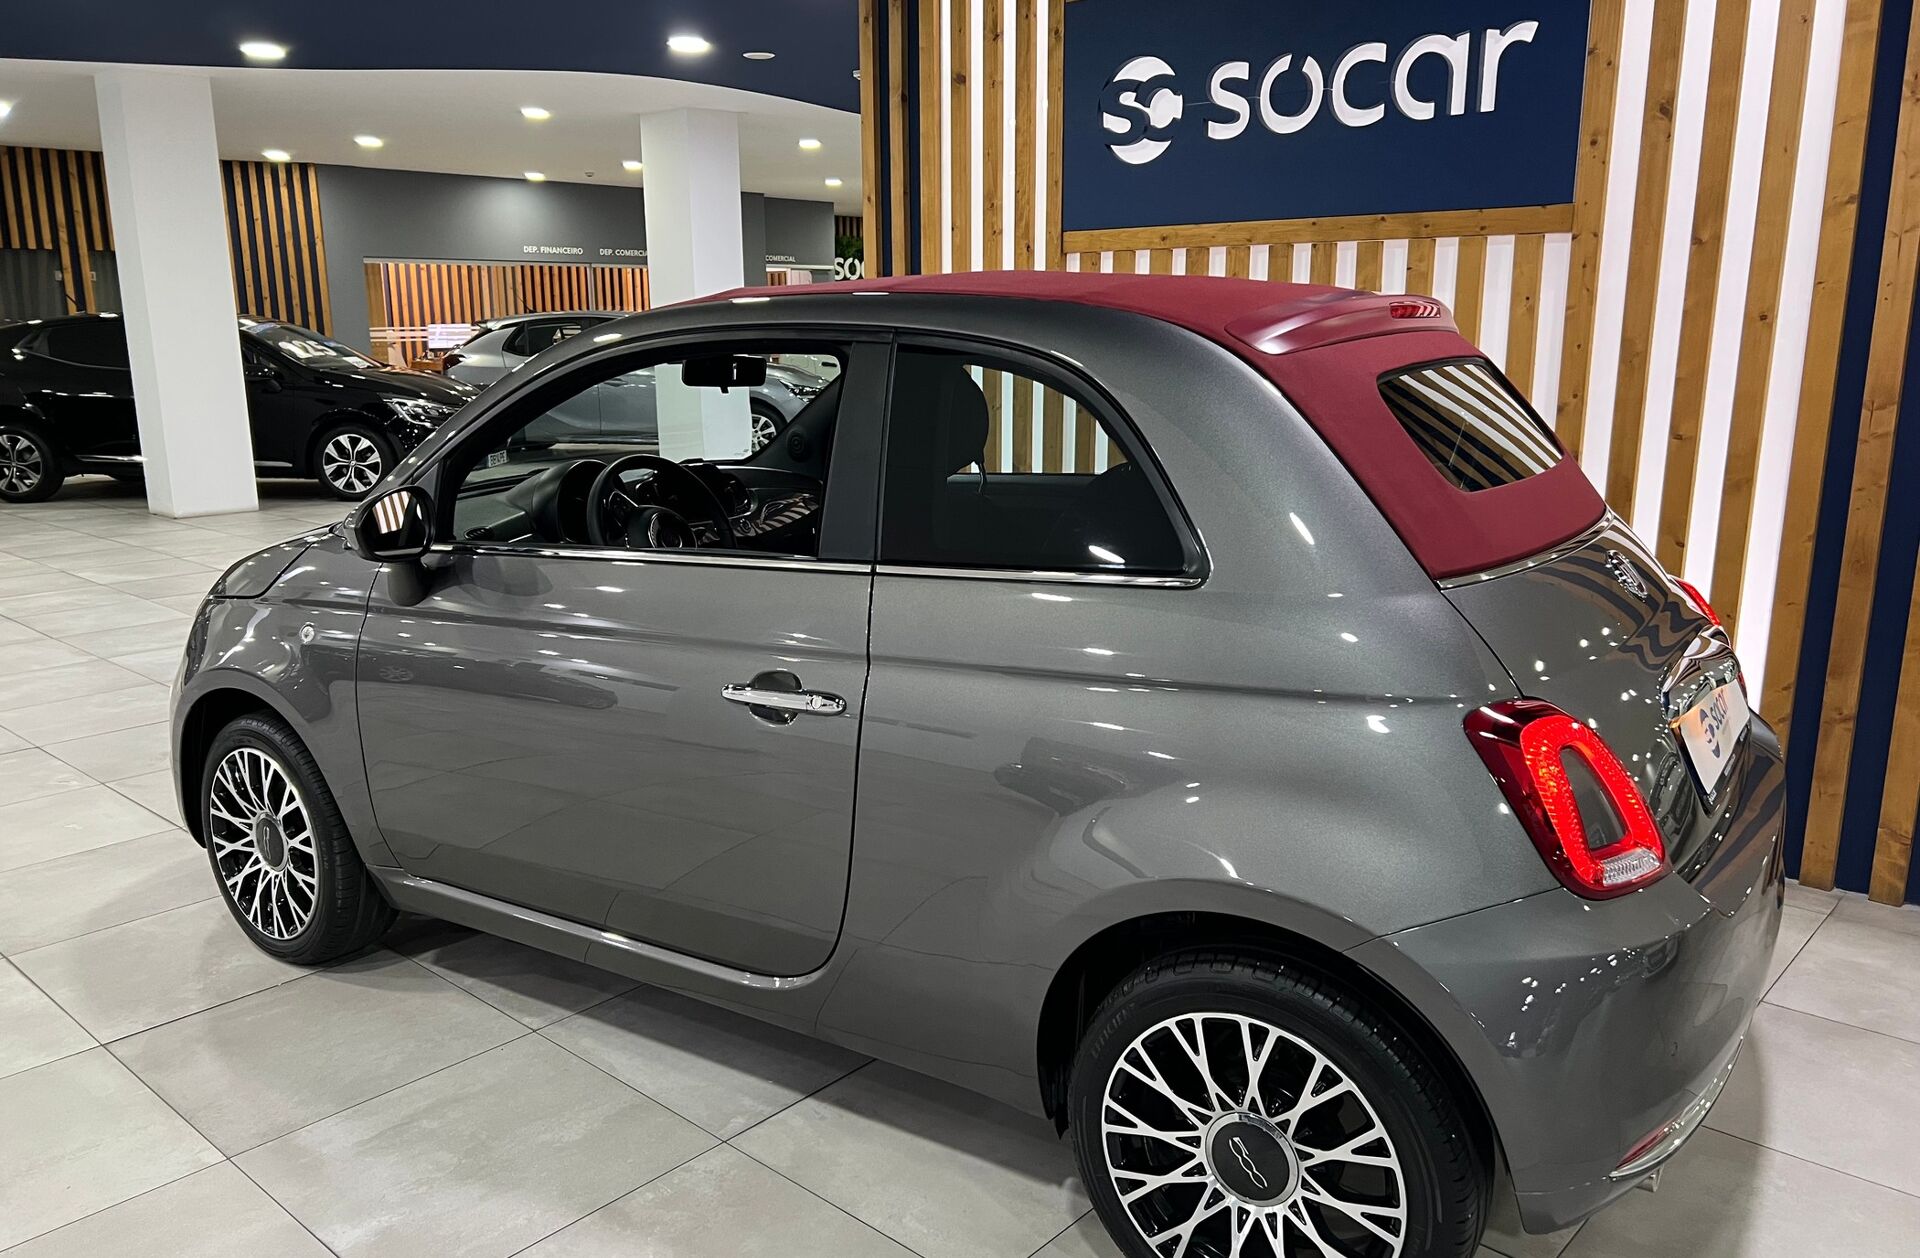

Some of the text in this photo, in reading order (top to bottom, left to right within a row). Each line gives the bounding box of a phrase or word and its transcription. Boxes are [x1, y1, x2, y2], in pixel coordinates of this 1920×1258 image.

[1203, 20, 1538, 140] socar
[523, 245, 583, 255] DEP. FINANCEIRO
[599, 248, 614, 256] DEP.
[765, 255, 796, 263] COMERCIAL
